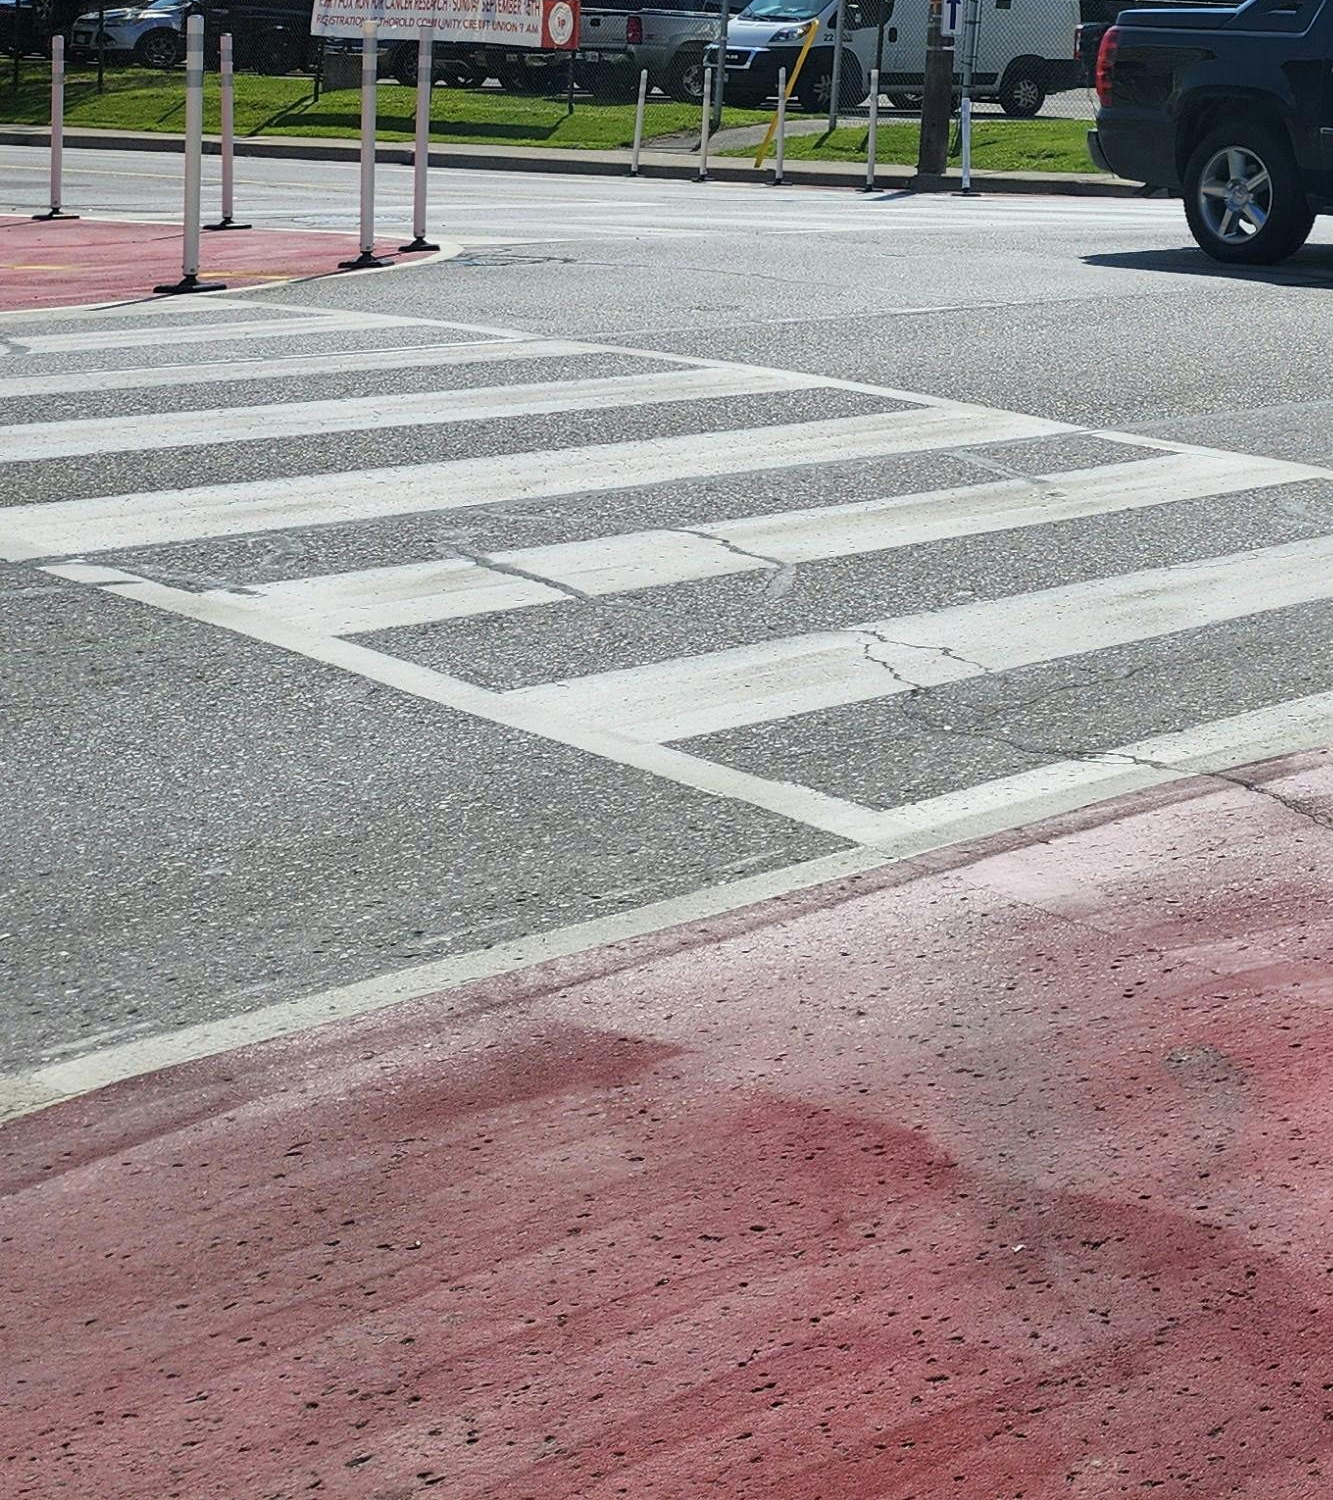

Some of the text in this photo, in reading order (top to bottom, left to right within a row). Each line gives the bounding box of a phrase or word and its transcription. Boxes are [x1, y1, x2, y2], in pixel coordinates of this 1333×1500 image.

[378, 16, 415, 28] THOROLD
[416, 17, 461, 29] COMMUNITY
[462, 19, 490, 30] CREDIT
[491, 20, 518, 33] UNION
